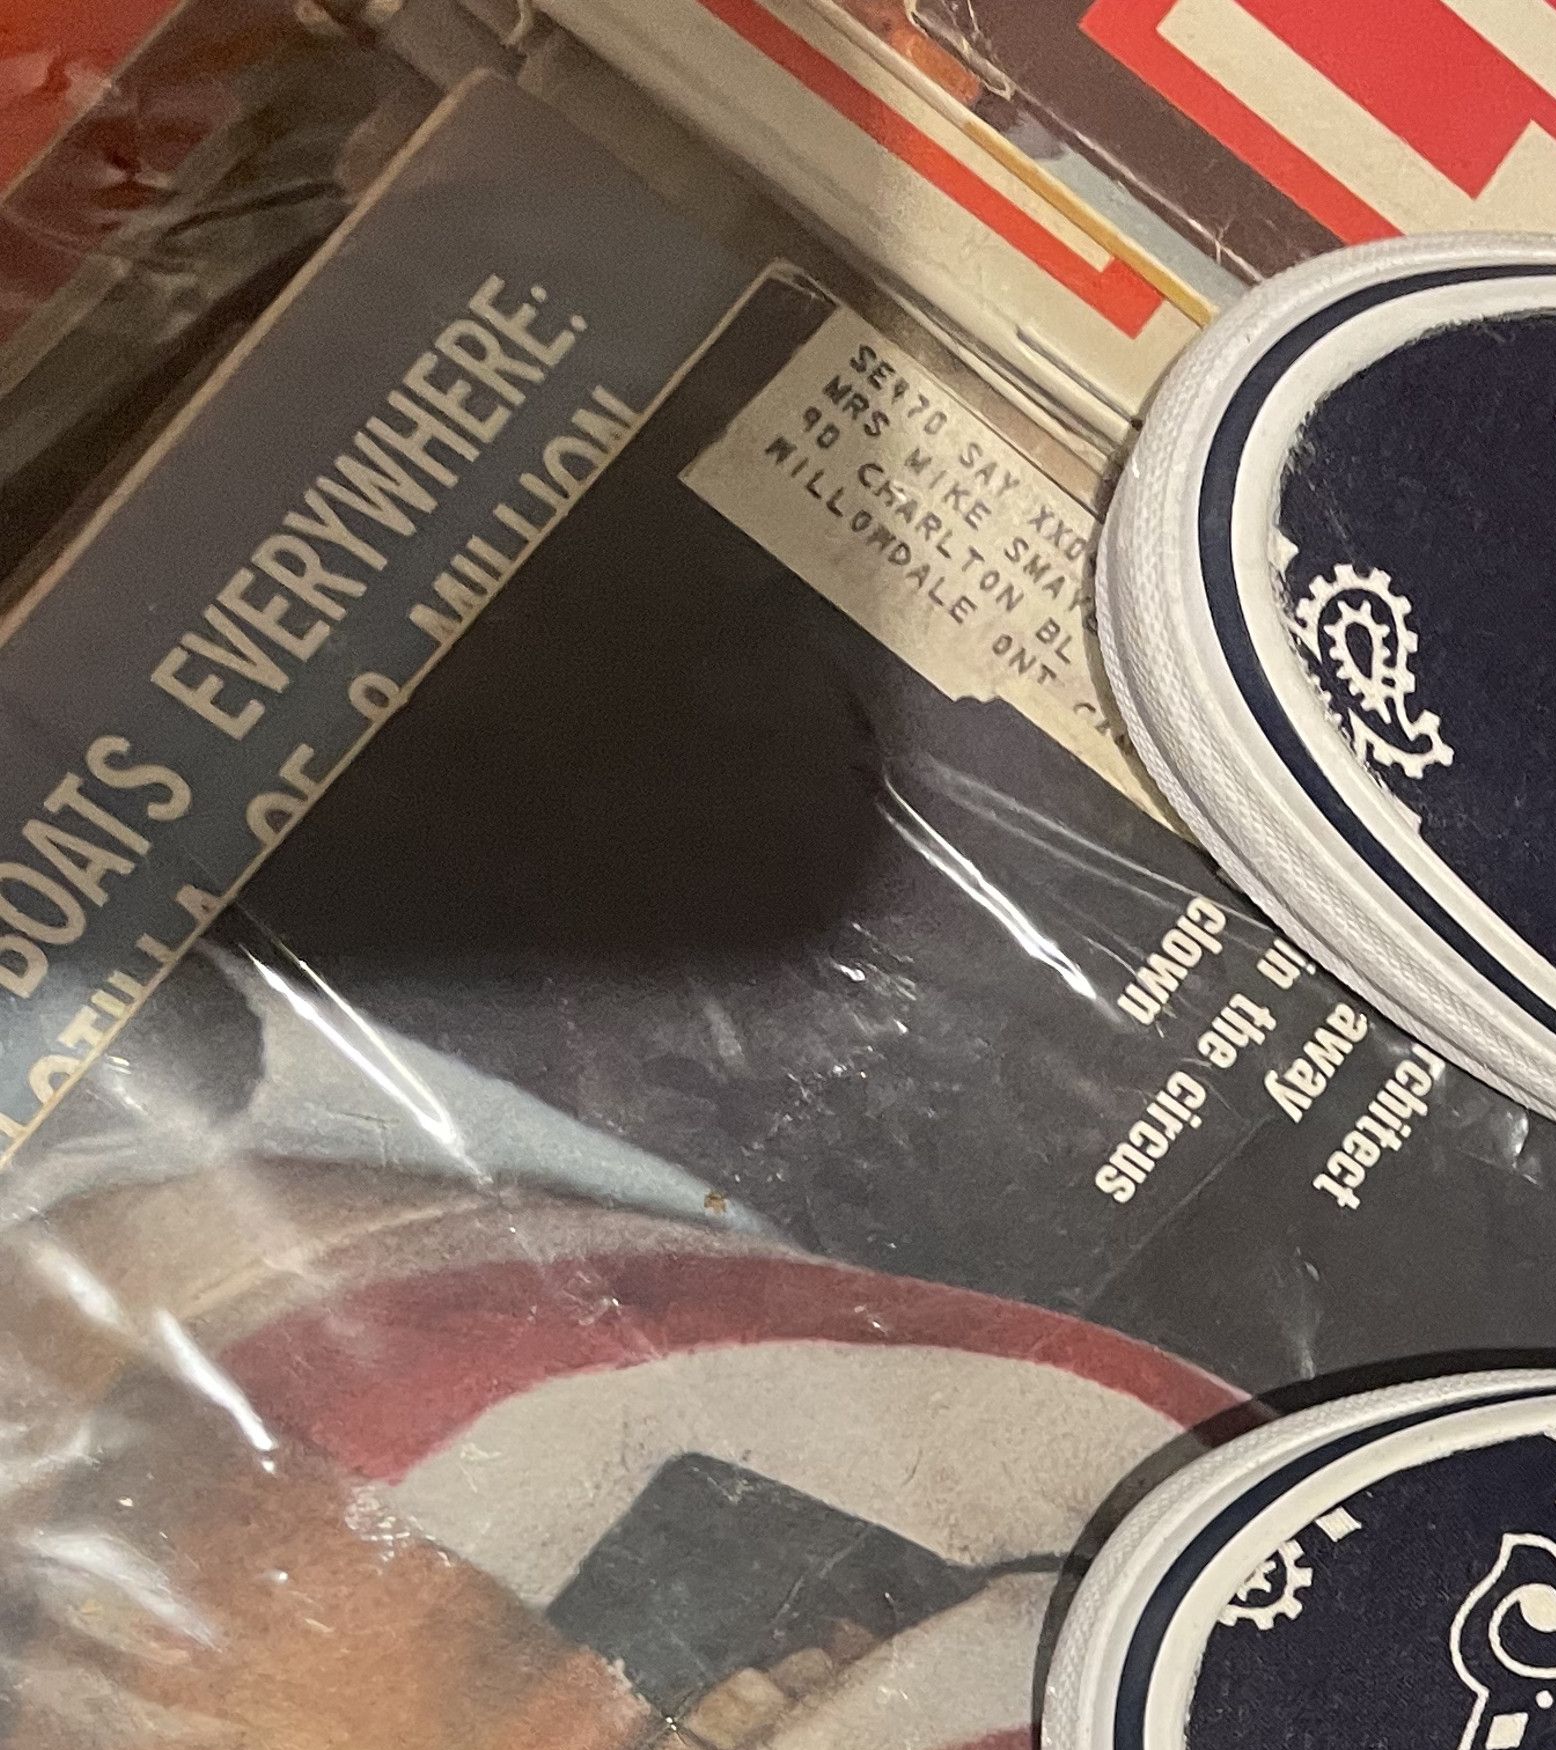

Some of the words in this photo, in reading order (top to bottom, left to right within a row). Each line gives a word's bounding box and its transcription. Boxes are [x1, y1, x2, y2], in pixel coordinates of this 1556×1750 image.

[151, 273, 588, 740] EVERYWHERE:
[822, 375, 890, 438] MRS
[905, 447, 992, 531] MIKE
[959, 442, 1021, 498] SAY
[765, 435, 979, 625] WILLOWDALE
[859, 461, 1026, 613] CHARLTON
[1117, 898, 1226, 1025] clown
[1257, 939, 1316, 989] in
[1198, 994, 1277, 1068] the
[1265, 1003, 1369, 1123] away
[1095, 1071, 1207, 1203] circus
[1312, 1043, 1446, 1209] rchitect
